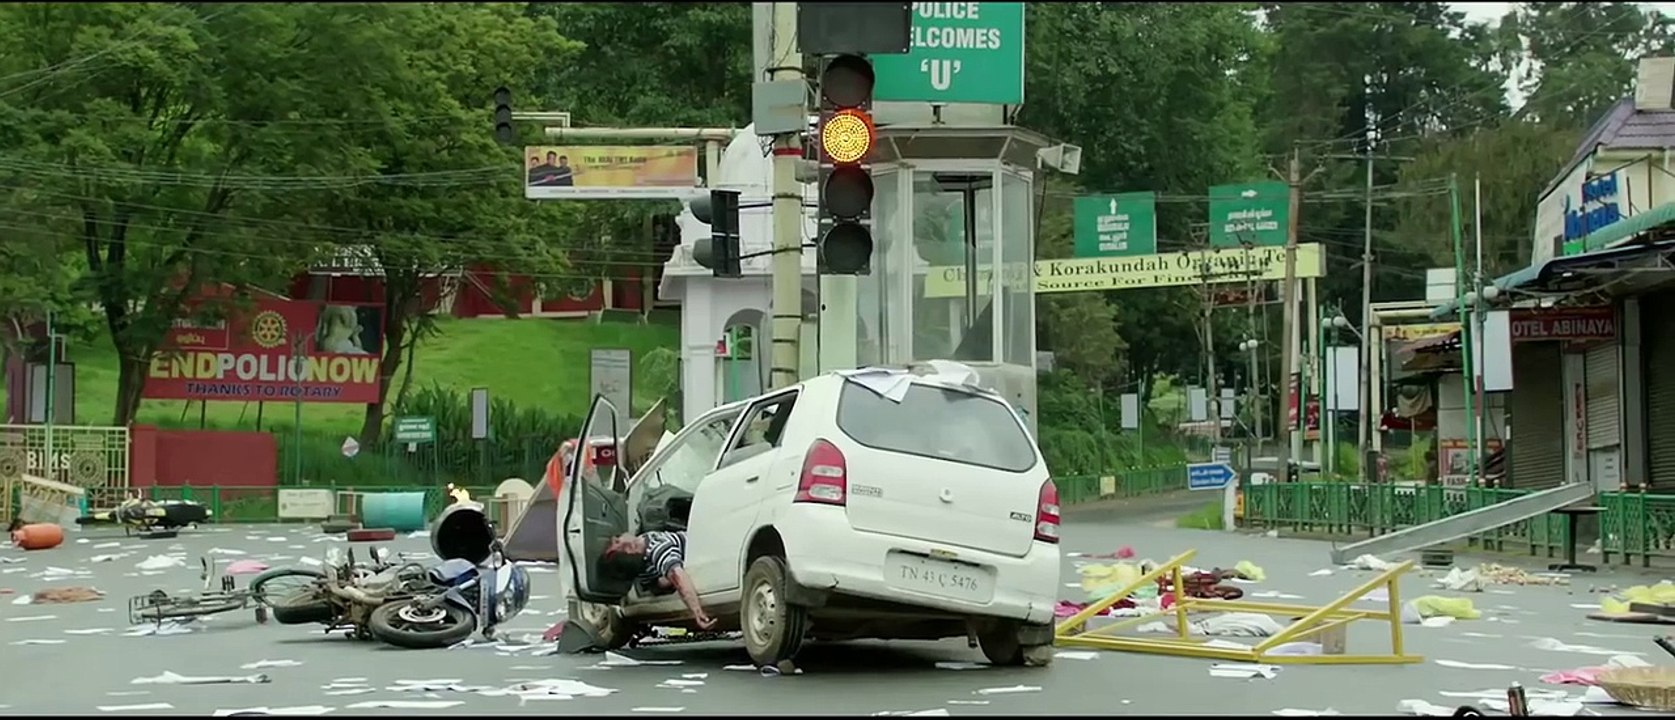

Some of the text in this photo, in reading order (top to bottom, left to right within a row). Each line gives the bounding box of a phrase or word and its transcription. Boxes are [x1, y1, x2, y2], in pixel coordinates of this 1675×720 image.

[1050, 256, 1168, 277] Korakundah
[1037, 278, 1104, 290] Source
[1112, 276, 1146, 286] For
[1551, 319, 1615, 336] ABINAYA
[185, 383, 341, 398] THANKS TO ROTARY
[900, 565, 918, 580] TN
[923, 570, 935, 584] 43
[951, 574, 978, 592] 5476
